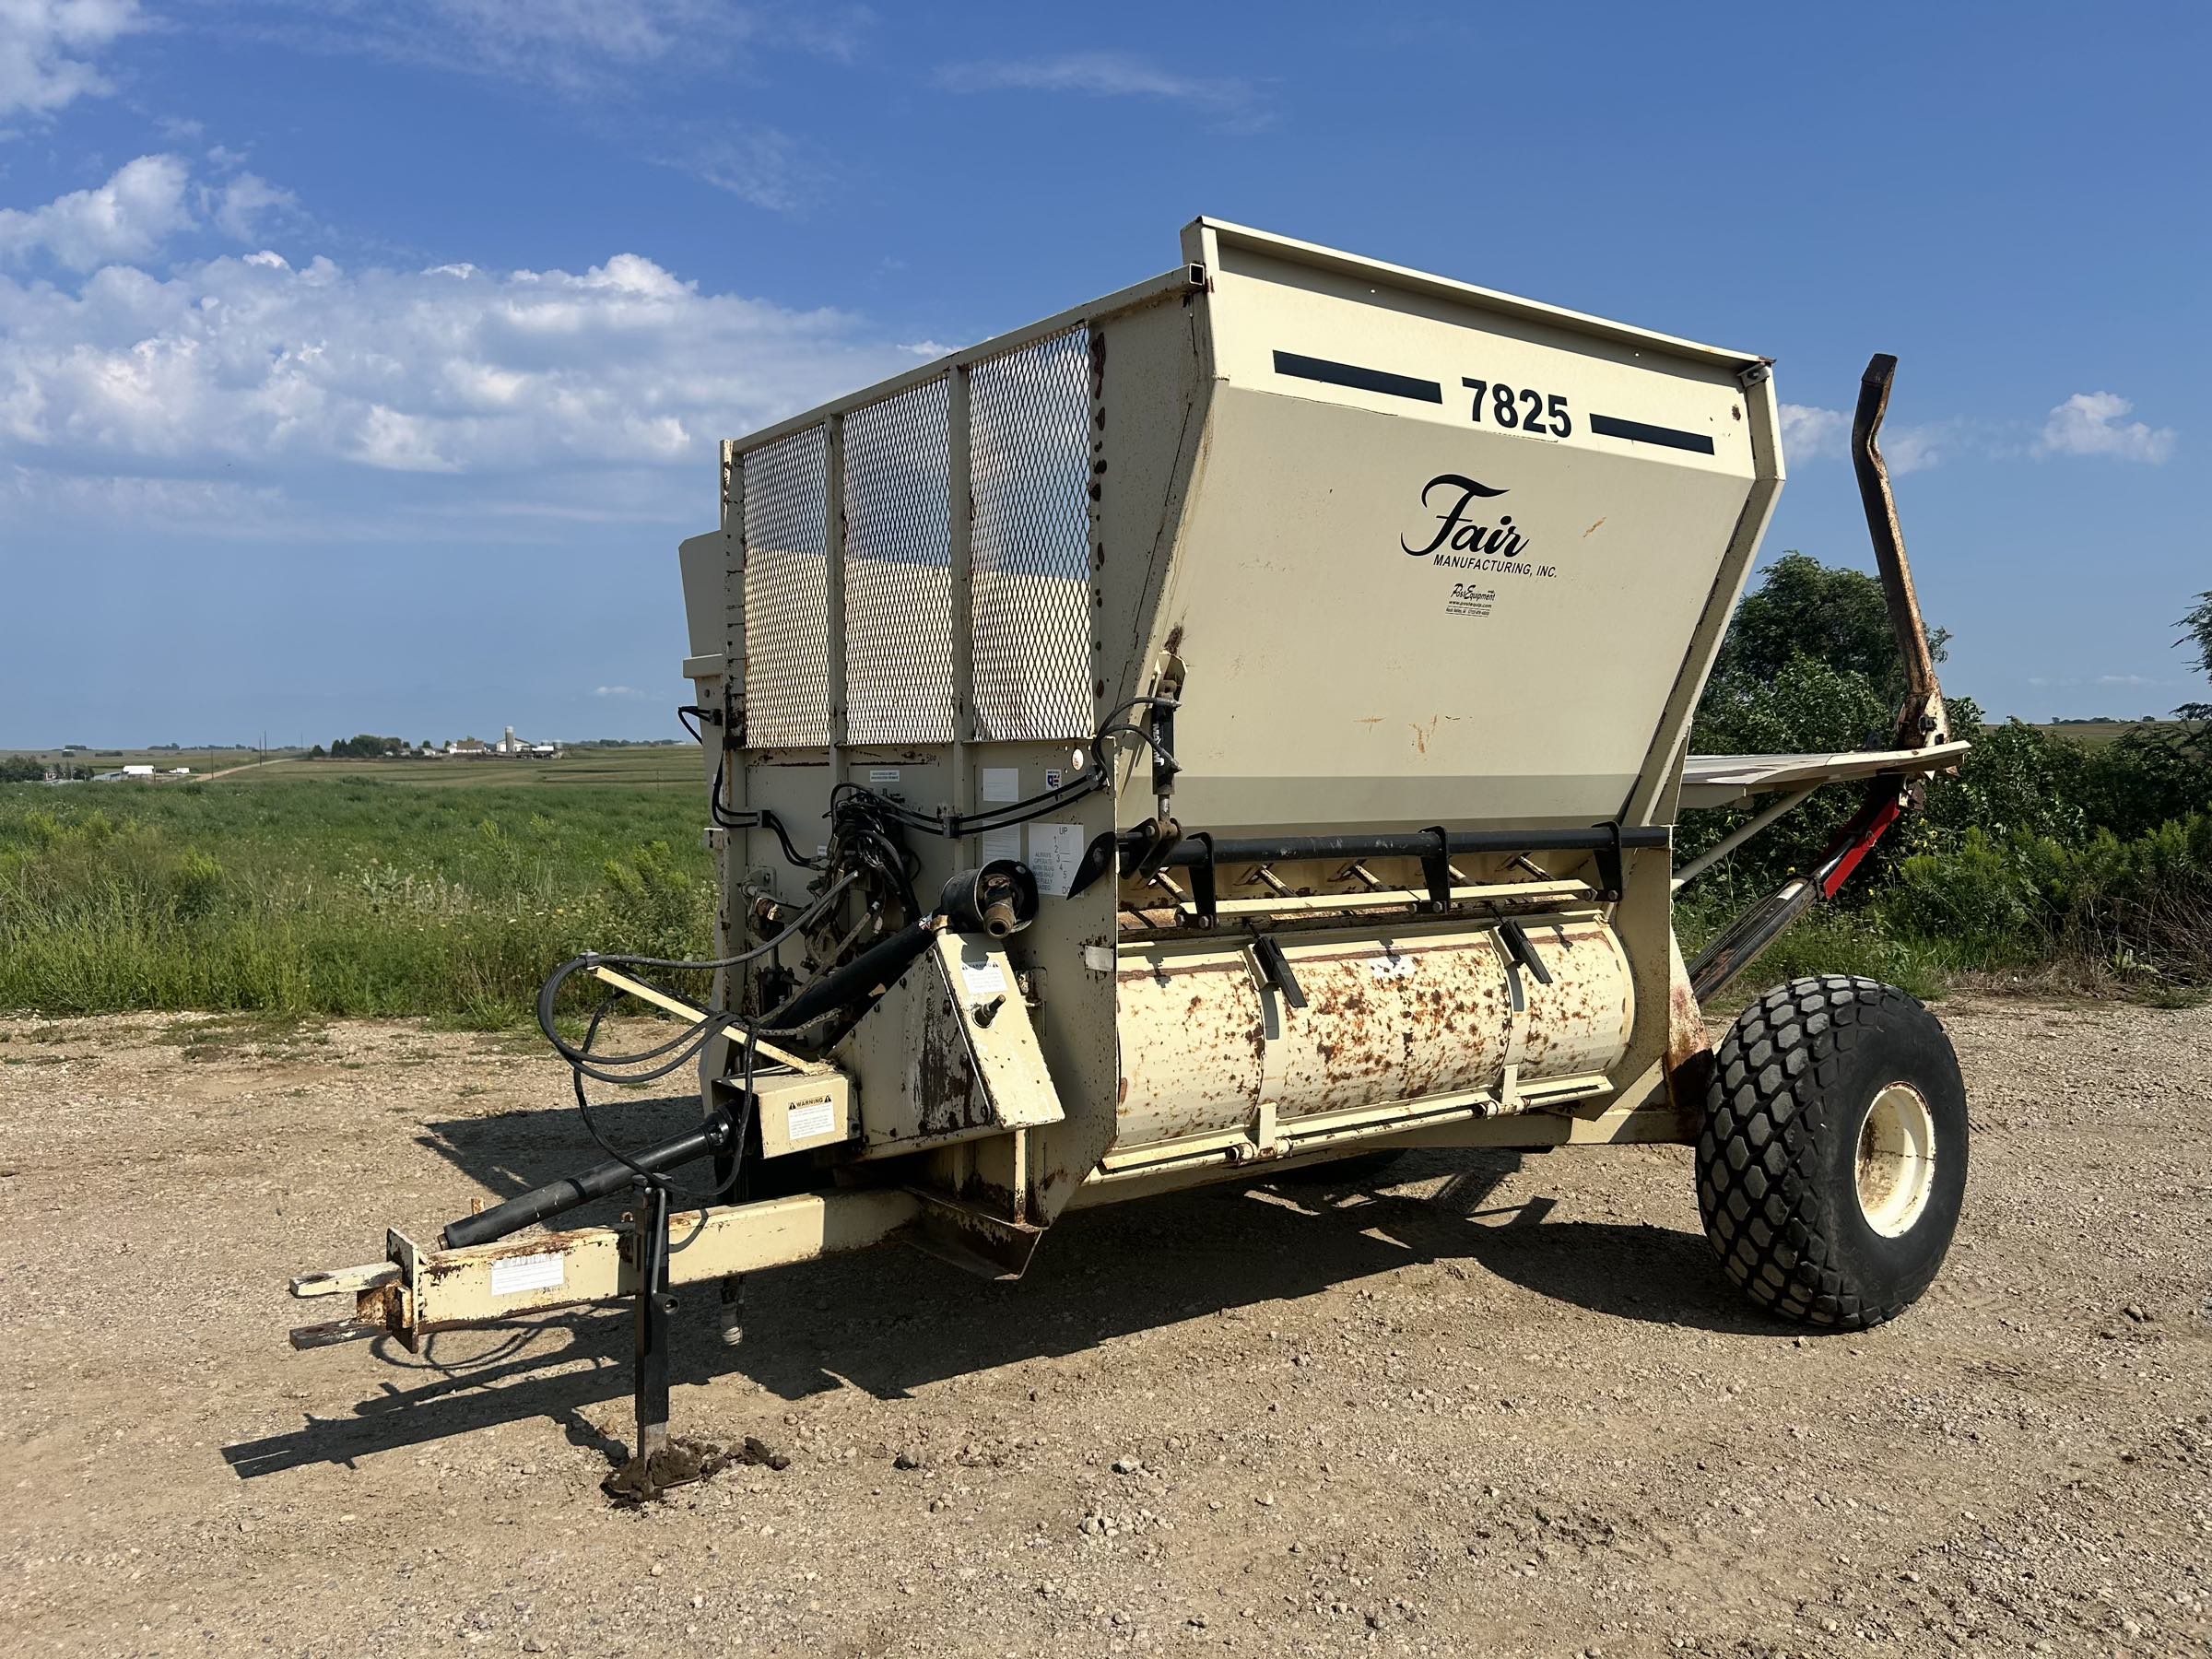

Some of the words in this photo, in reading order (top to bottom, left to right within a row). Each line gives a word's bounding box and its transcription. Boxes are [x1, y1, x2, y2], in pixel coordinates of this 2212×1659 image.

[1462, 376, 1572, 438] 7825
[1400, 474, 1530, 558] Fair
[1433, 554, 1533, 577] MANUFACTURING,
[1536, 565, 1558, 578] INC.
[1059, 827, 1067, 835] UP
[1053, 844, 1059, 853] 2
[1056, 854, 1061, 863] 3
[1063, 871, 1067, 879] 5
[796, 1097, 823, 1106] WARNING
[510, 1253, 547, 1266] CAUTION
